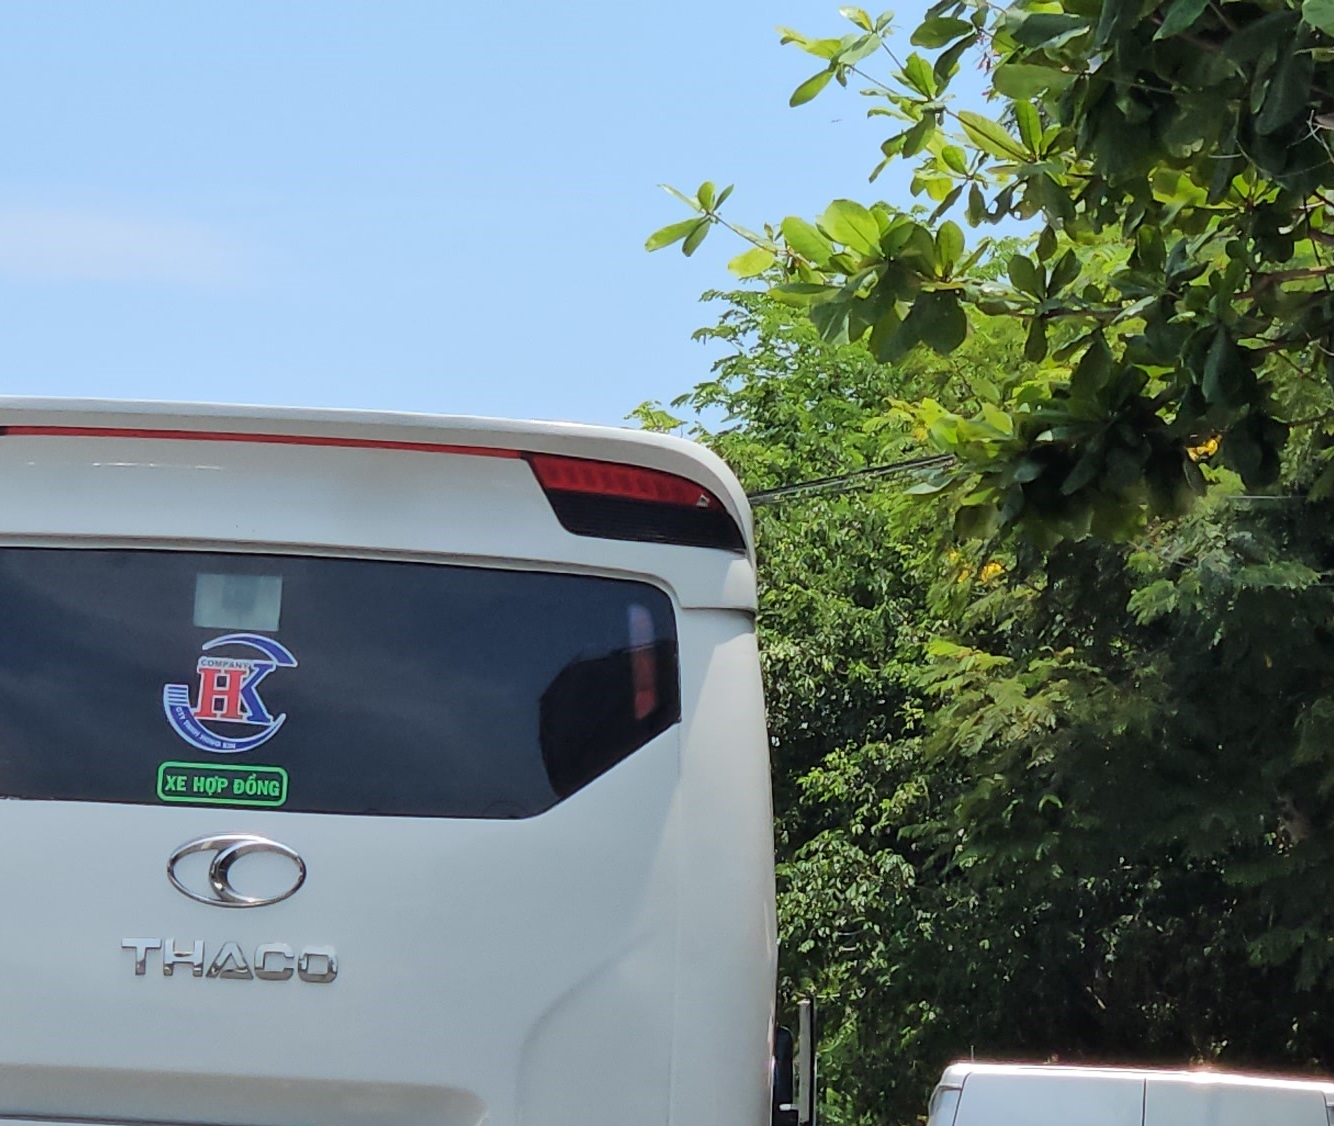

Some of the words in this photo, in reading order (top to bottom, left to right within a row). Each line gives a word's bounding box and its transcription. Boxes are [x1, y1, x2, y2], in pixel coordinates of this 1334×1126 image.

[201, 659, 250, 669] COMPANY
[165, 775, 187, 791] XE
[193, 775, 228, 796] HỢP
[233, 772, 280, 797] ĐỒNG
[121, 937, 338, 983] THACO
